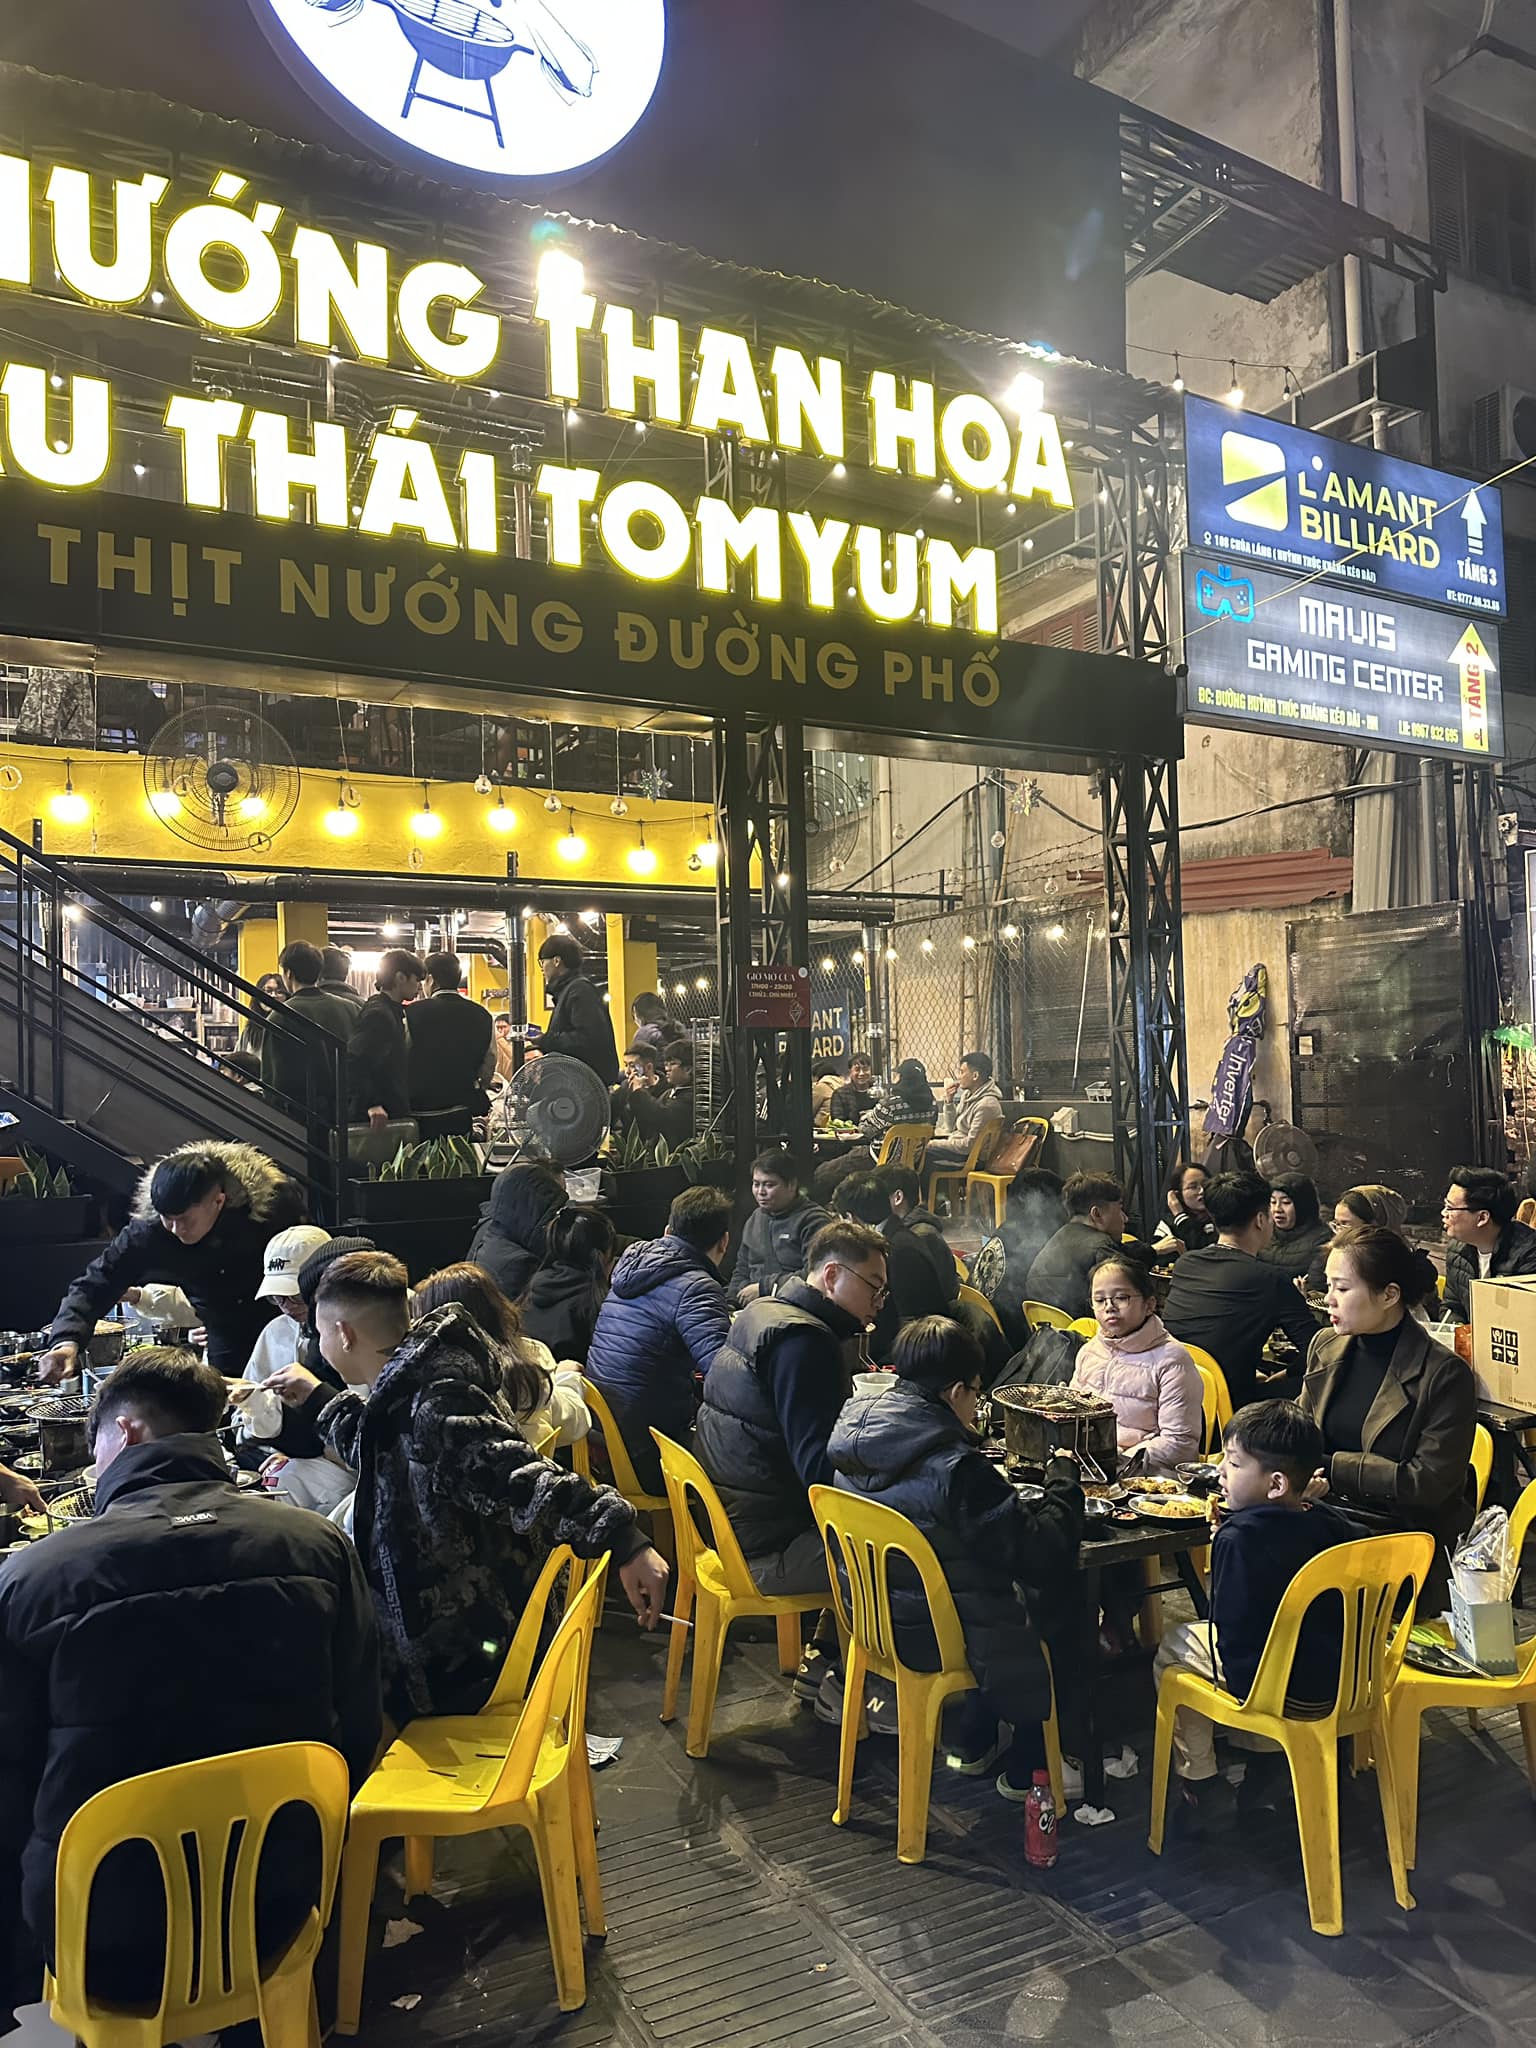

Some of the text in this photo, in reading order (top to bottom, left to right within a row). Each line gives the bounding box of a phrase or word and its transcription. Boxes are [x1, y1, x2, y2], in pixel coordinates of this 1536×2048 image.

[533, 289, 846, 458] THAN
[0, 361, 999, 636] U THÁI TOMYUM
[1299, 504, 1440, 569] BILLIARD
[1488, 568, 1498, 587] 3
[37, 523, 1001, 708] THỊT NƯỚNG ĐƯỜNG PHỐ
[1247, 638, 1444, 704] GAMING CENTER
[1465, 641, 1479, 656] 2
[1039, 1812, 1056, 1834] C2
